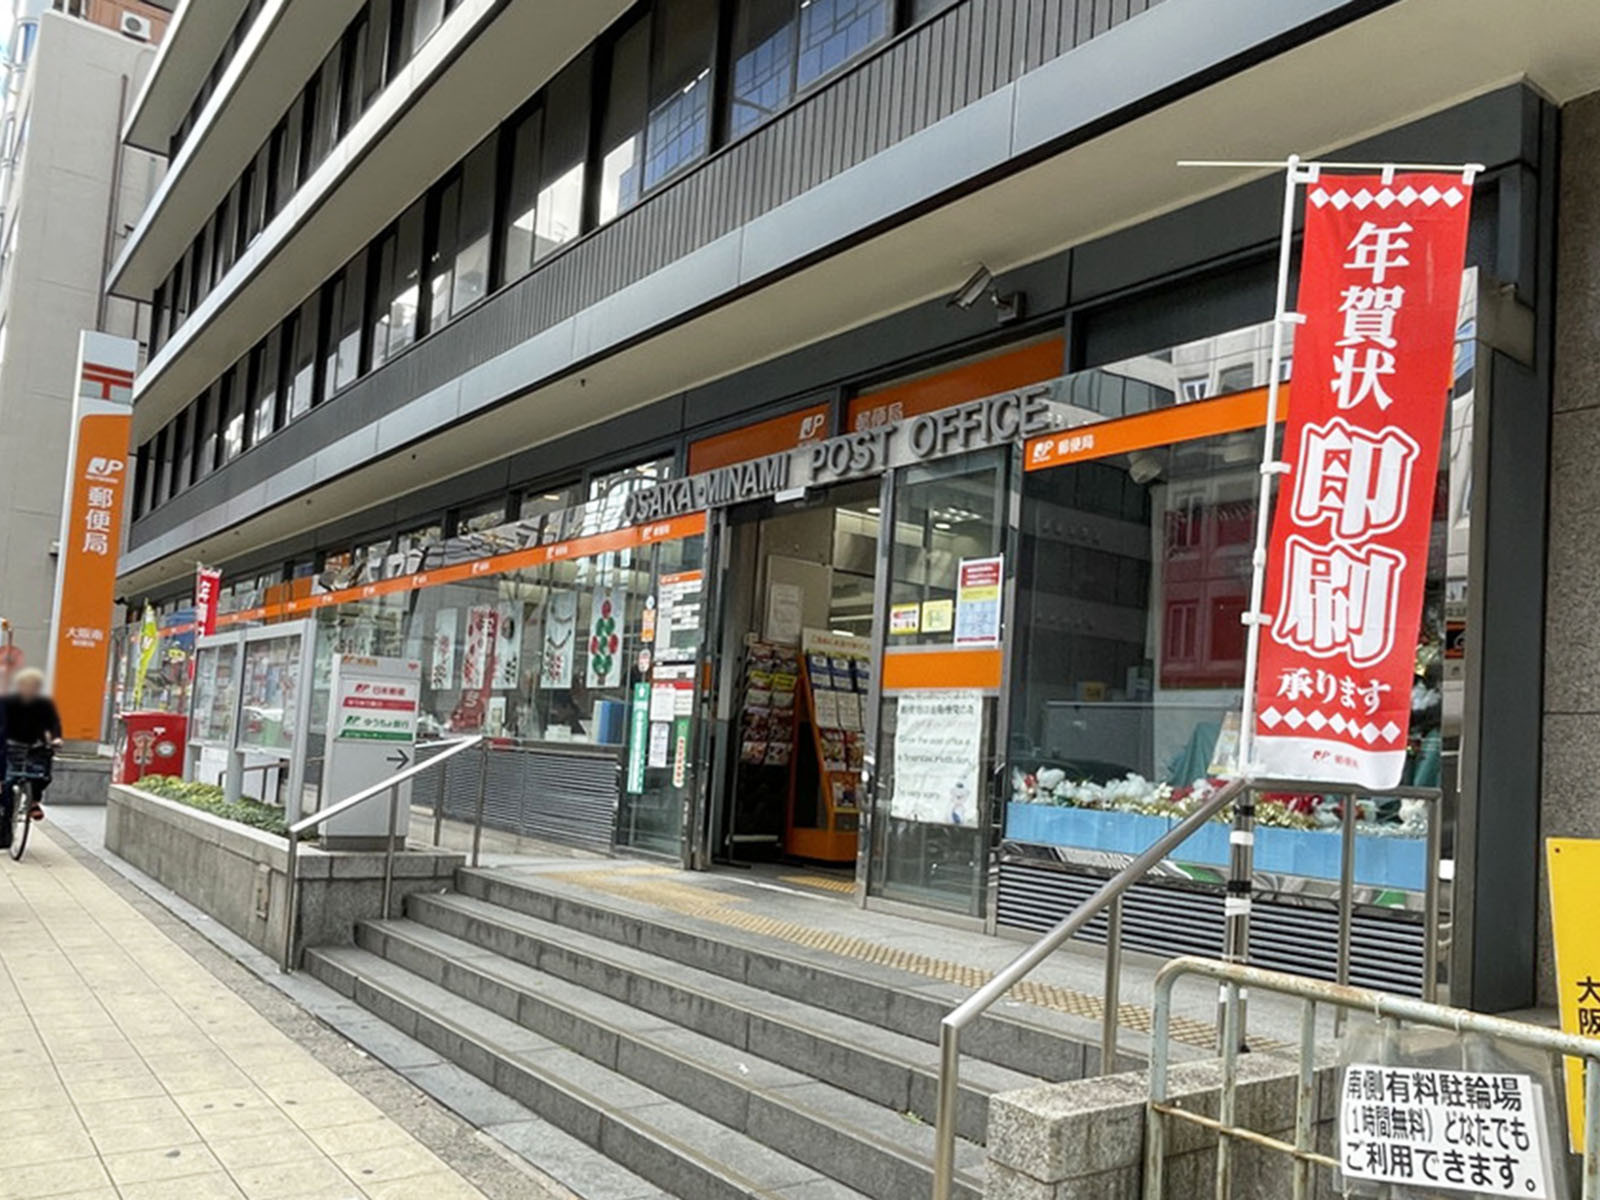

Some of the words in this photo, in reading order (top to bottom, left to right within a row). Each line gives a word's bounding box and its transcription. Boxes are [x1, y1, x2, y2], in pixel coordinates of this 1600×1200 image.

[809, 423, 900, 482] POST
[908, 385, 1050, 459] OFFICE
[82, 486, 114, 555] 郵便局
[1276, 667, 1391, 716] 承ります
[1347, 1069, 1522, 1112] 南側有料駐輪場
[1346, 1141, 1536, 1192] ご利用できます。
